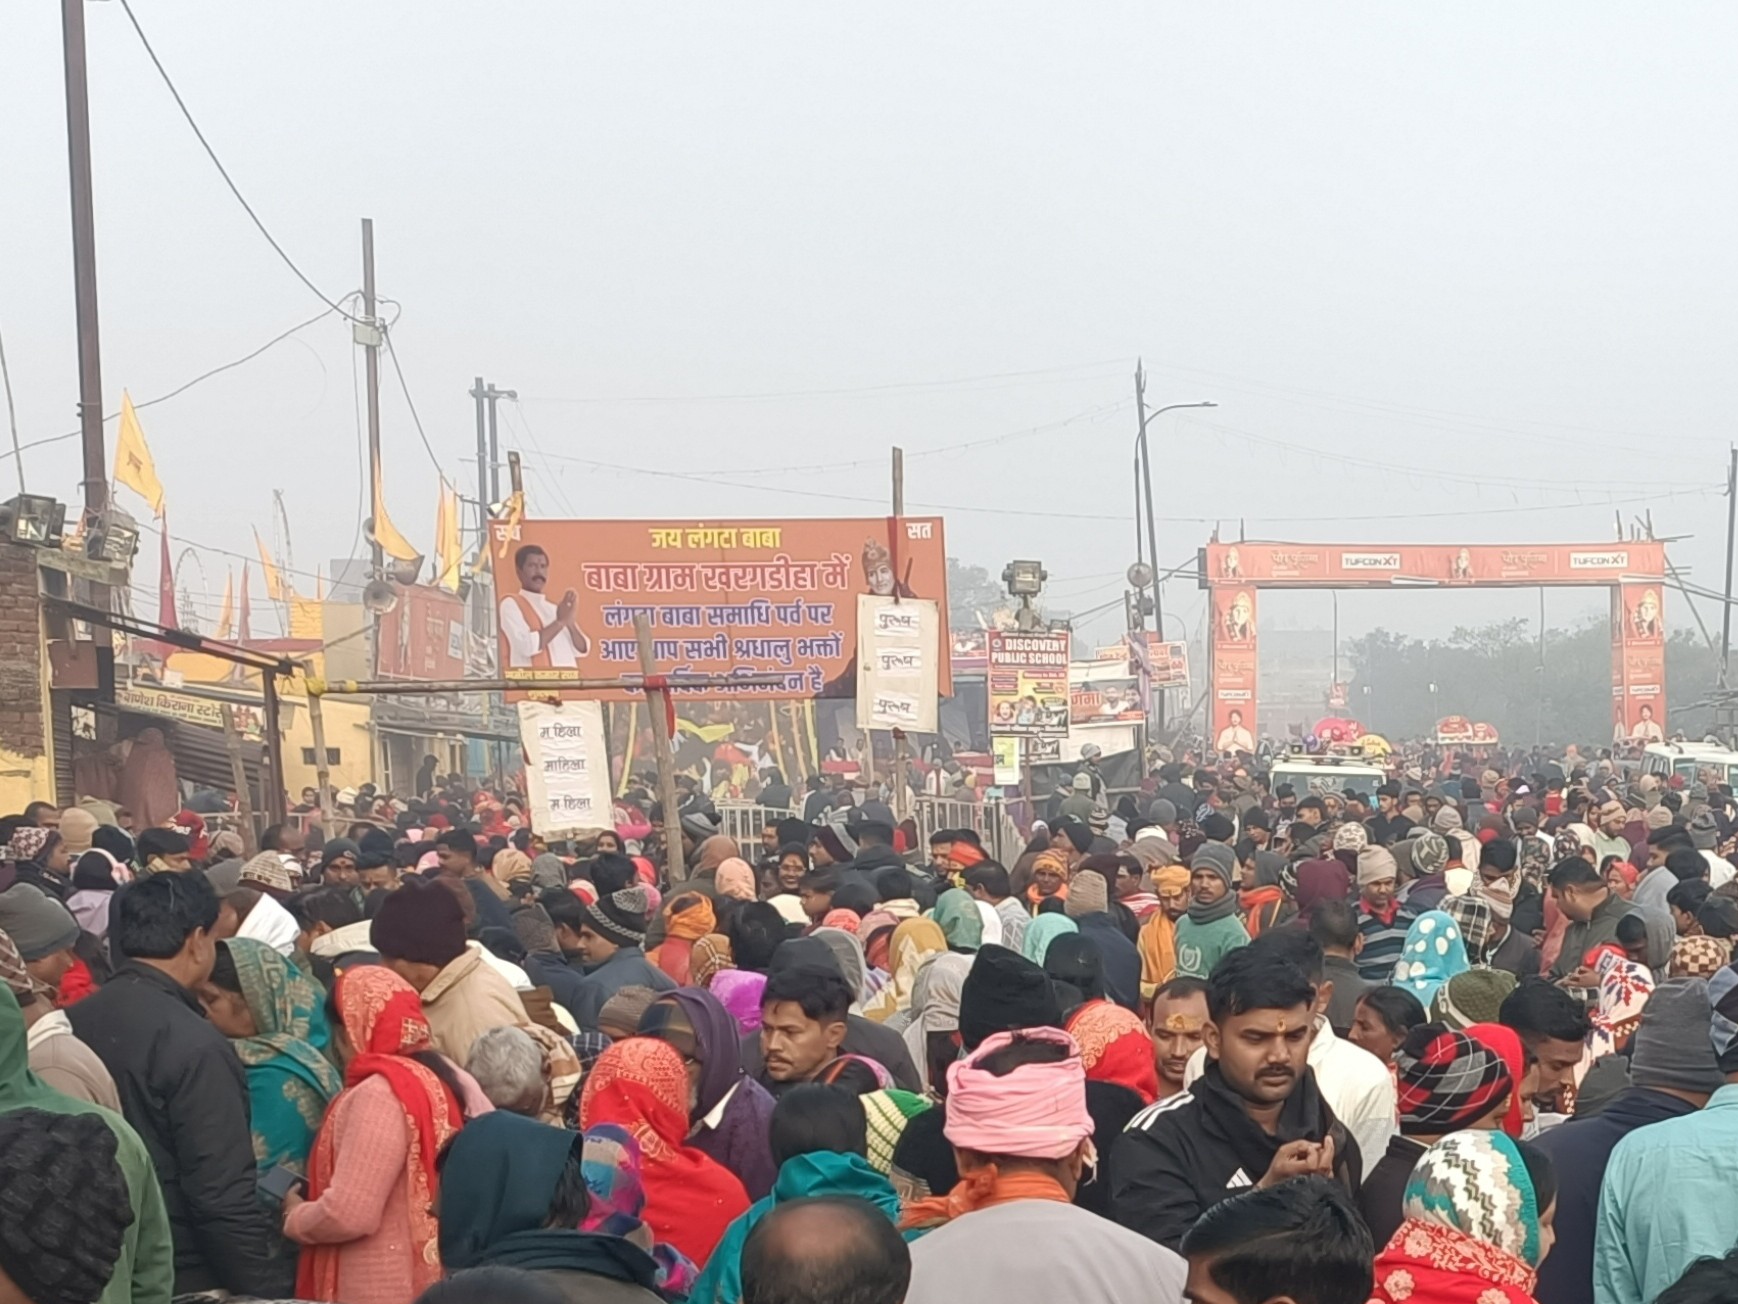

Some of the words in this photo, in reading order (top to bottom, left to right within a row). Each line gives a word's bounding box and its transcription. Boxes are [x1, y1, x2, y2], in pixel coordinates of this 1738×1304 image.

[649, 528, 682, 548] जय
[685, 522, 737, 548] लंगटा
[740, 528, 781, 548] बाबा
[906, 522, 932, 539] सत
[1345, 557, 1382, 566] TUFCON
[1383, 555, 1398, 566] XT
[1573, 557, 1609, 566] TUFCON
[1610, 554, 1626, 565] XT
[581, 563, 639, 591] बाबा
[643, 563, 698, 591] ग्राम
[700, 554, 818, 591] खरगडीहा
[819, 554, 852, 590] में
[660, 605, 701, 627] बाबा
[705, 599, 771, 626] समाधि
[775, 598, 803, 625] पर्व
[806, 604, 833, 625] पर
[600, 639, 638, 661] आए
[683, 633, 727, 660] सभी
[797, 632, 845, 658] भक्तों
[1005, 638, 1067, 652] DISCOVERY
[991, 651, 1027, 664] PUBLIC
[1028, 652, 1067, 665] SCHOOL
[807, 664, 824, 692] है
[156, 694, 195, 713] किराना
